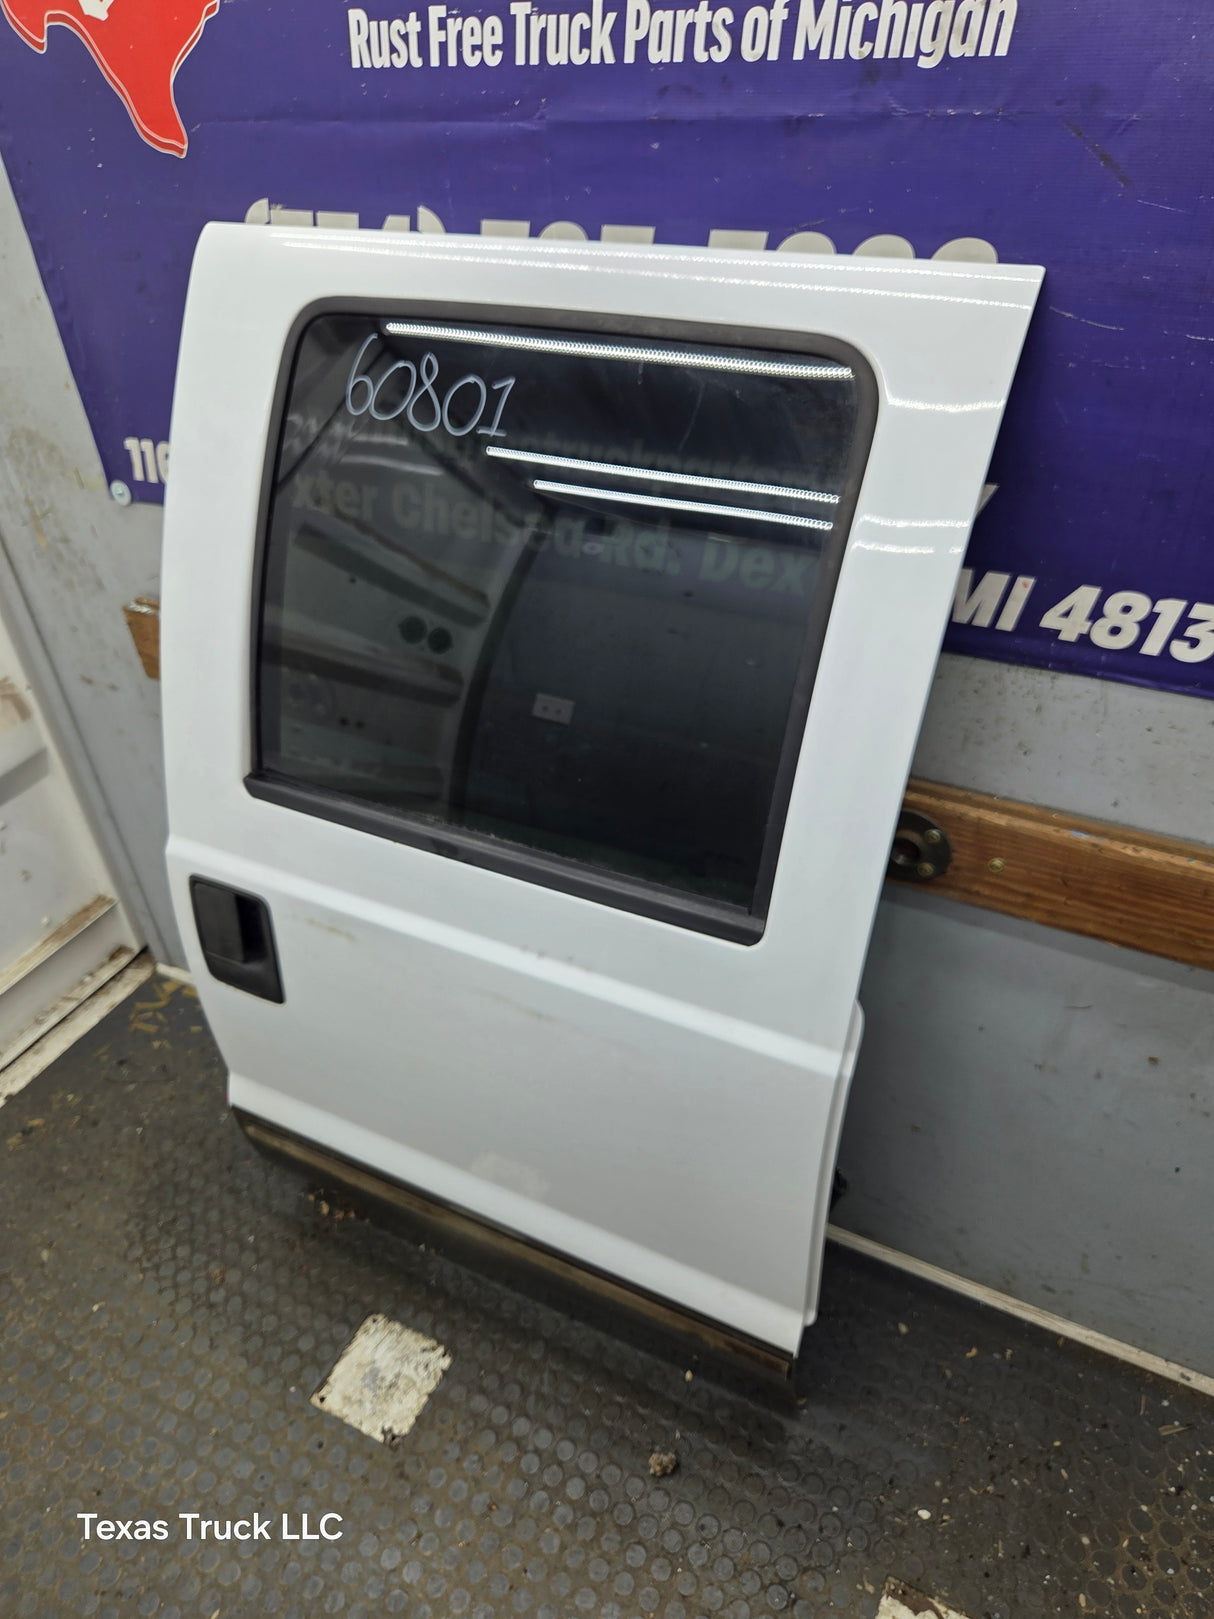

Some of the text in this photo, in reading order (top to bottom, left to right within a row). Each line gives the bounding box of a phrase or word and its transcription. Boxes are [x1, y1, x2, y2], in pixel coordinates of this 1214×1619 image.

[348, 0, 1019, 69] Rust Free Truck Parts of Michigan
[344, 332, 516, 437] 60801
[951, 568, 1036, 632] MI
[1039, 584, 1214, 664] 4813
